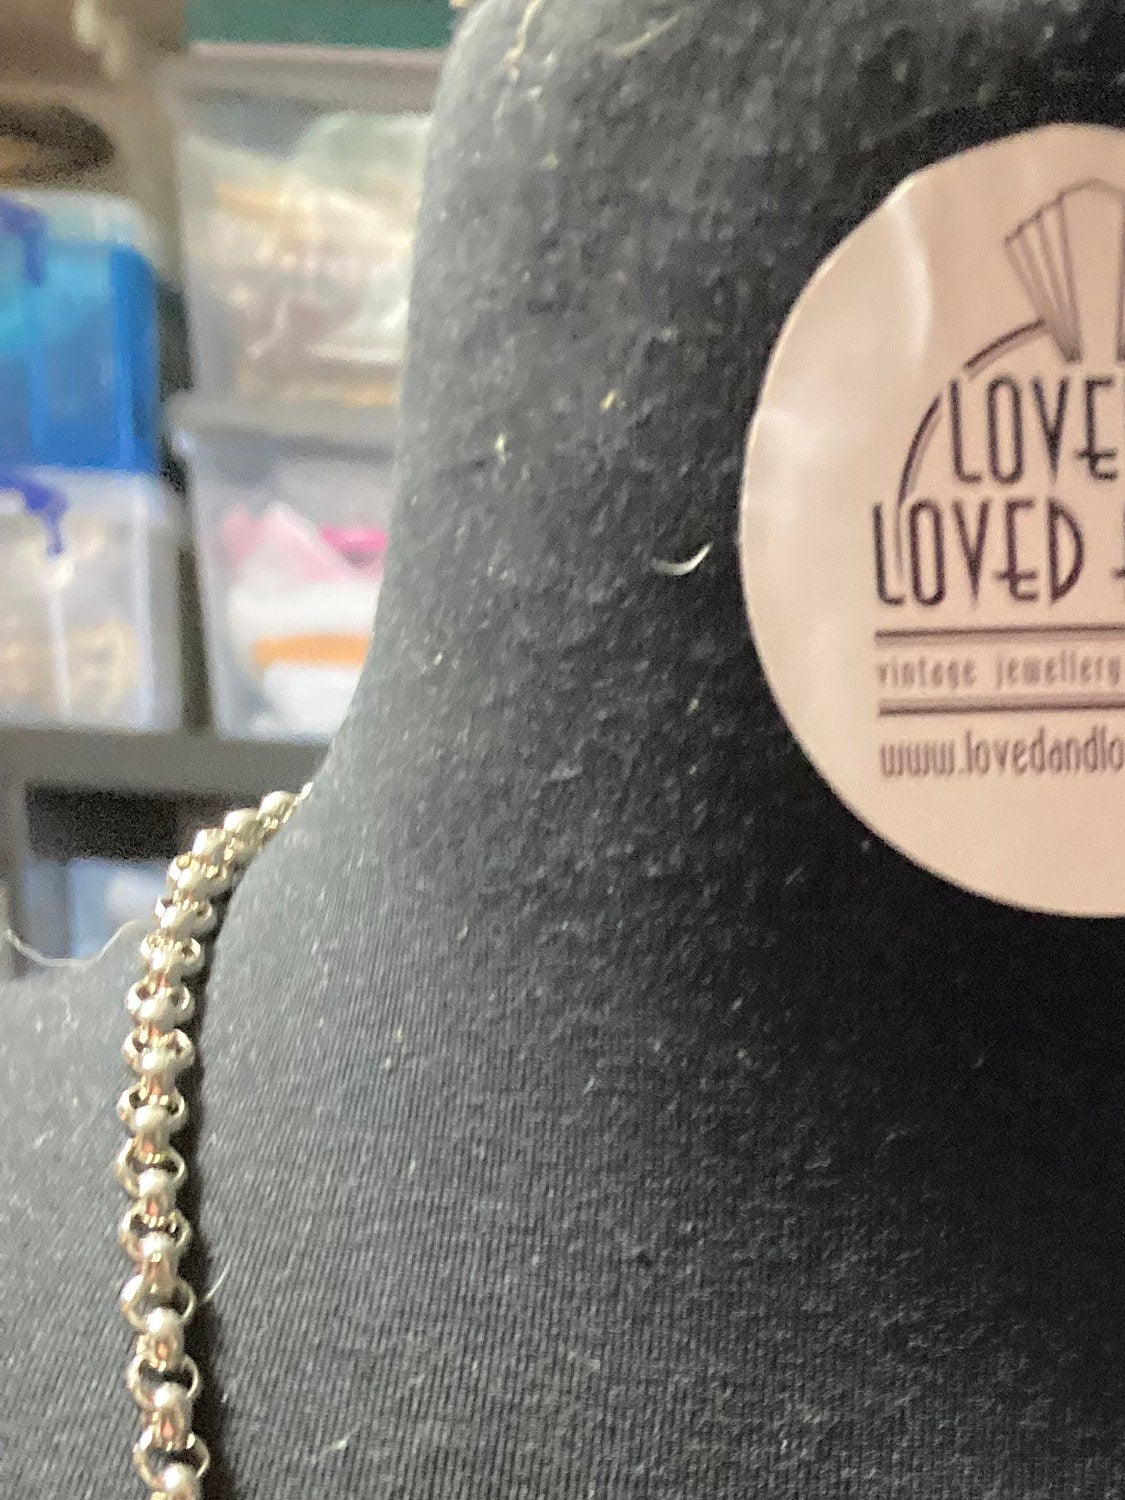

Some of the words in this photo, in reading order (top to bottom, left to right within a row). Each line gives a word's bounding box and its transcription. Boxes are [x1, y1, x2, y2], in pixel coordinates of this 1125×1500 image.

[872, 497, 1085, 607] LOVED
[876, 652, 977, 689] vintage
[996, 649, 1122, 689] jewellery
